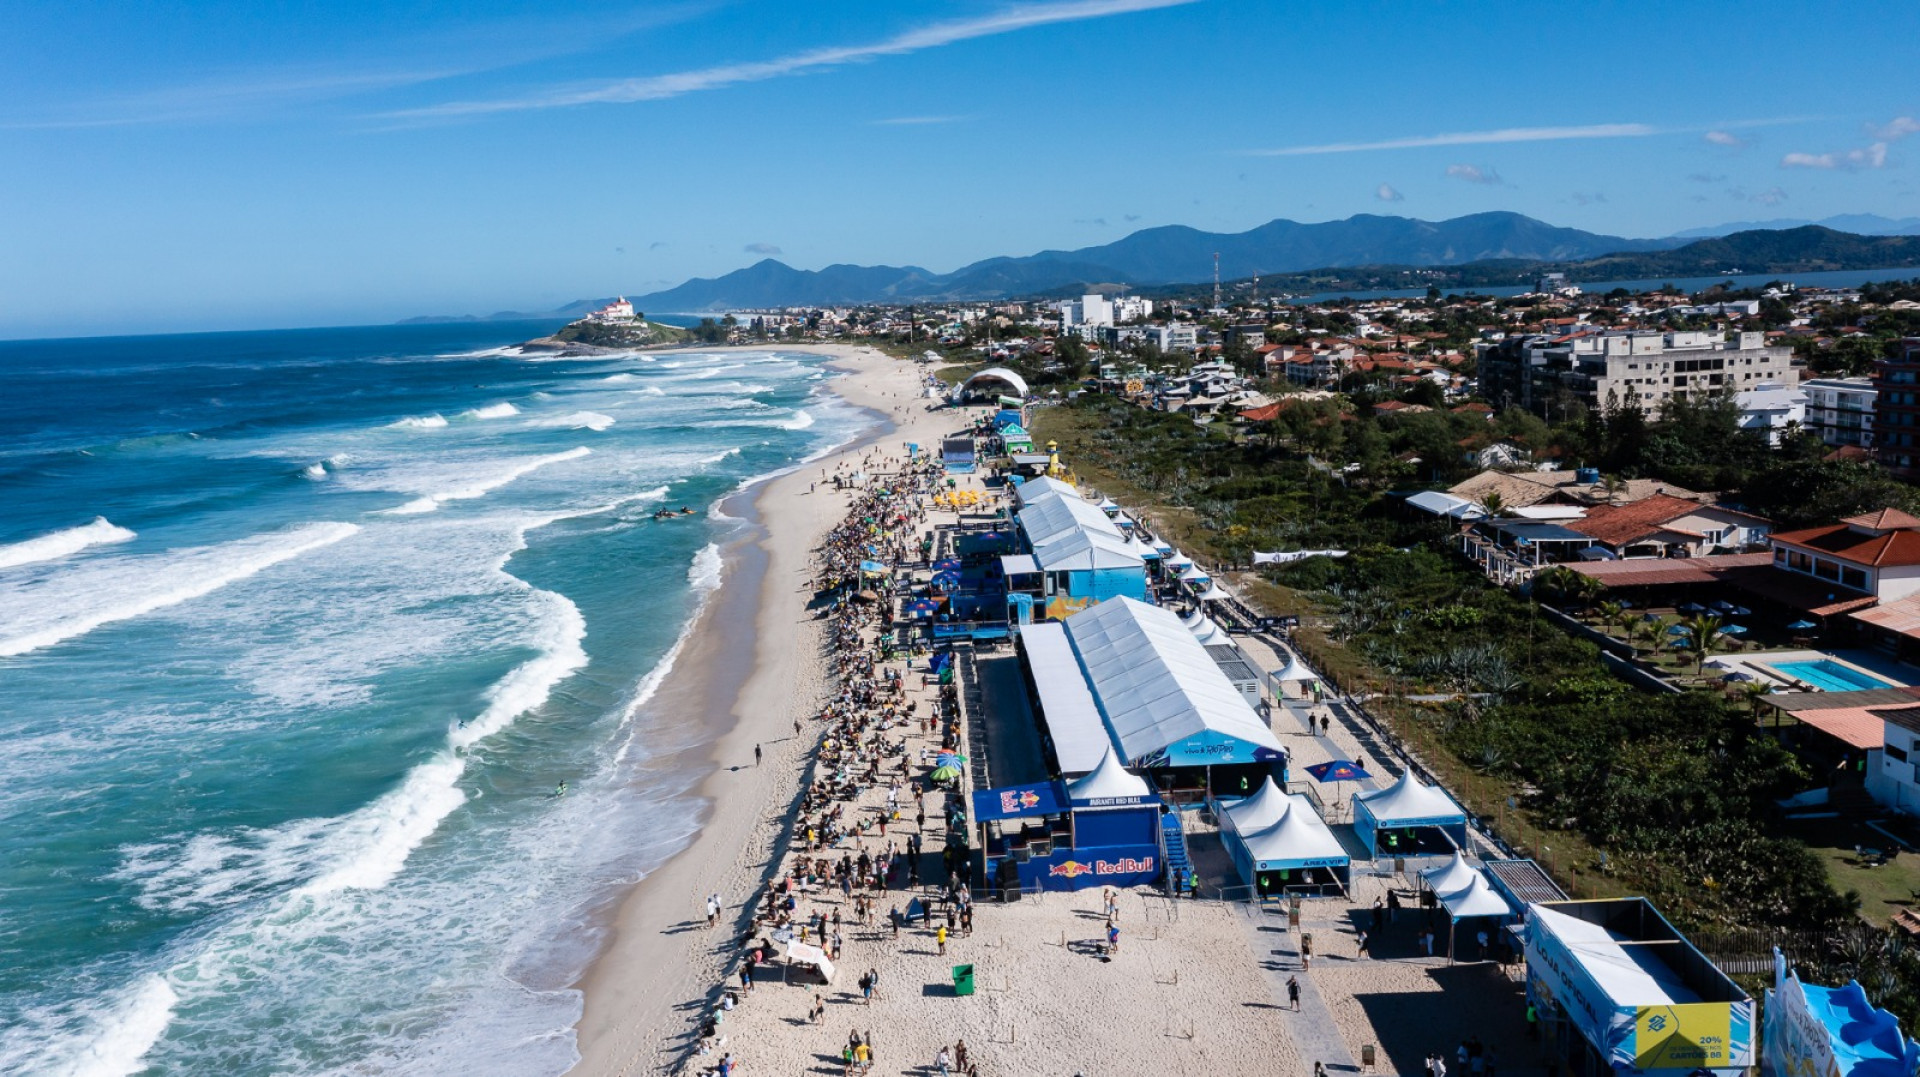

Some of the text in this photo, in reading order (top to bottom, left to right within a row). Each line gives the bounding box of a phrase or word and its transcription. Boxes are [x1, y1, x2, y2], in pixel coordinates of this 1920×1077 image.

[1096, 857, 1153, 874] Red Bull
[1303, 859, 1327, 867] ÁREA
[1536, 941, 1560, 976] LOJA
[1561, 970, 1598, 1025] OFICIAL
[1699, 1036, 1722, 1044] 20%
